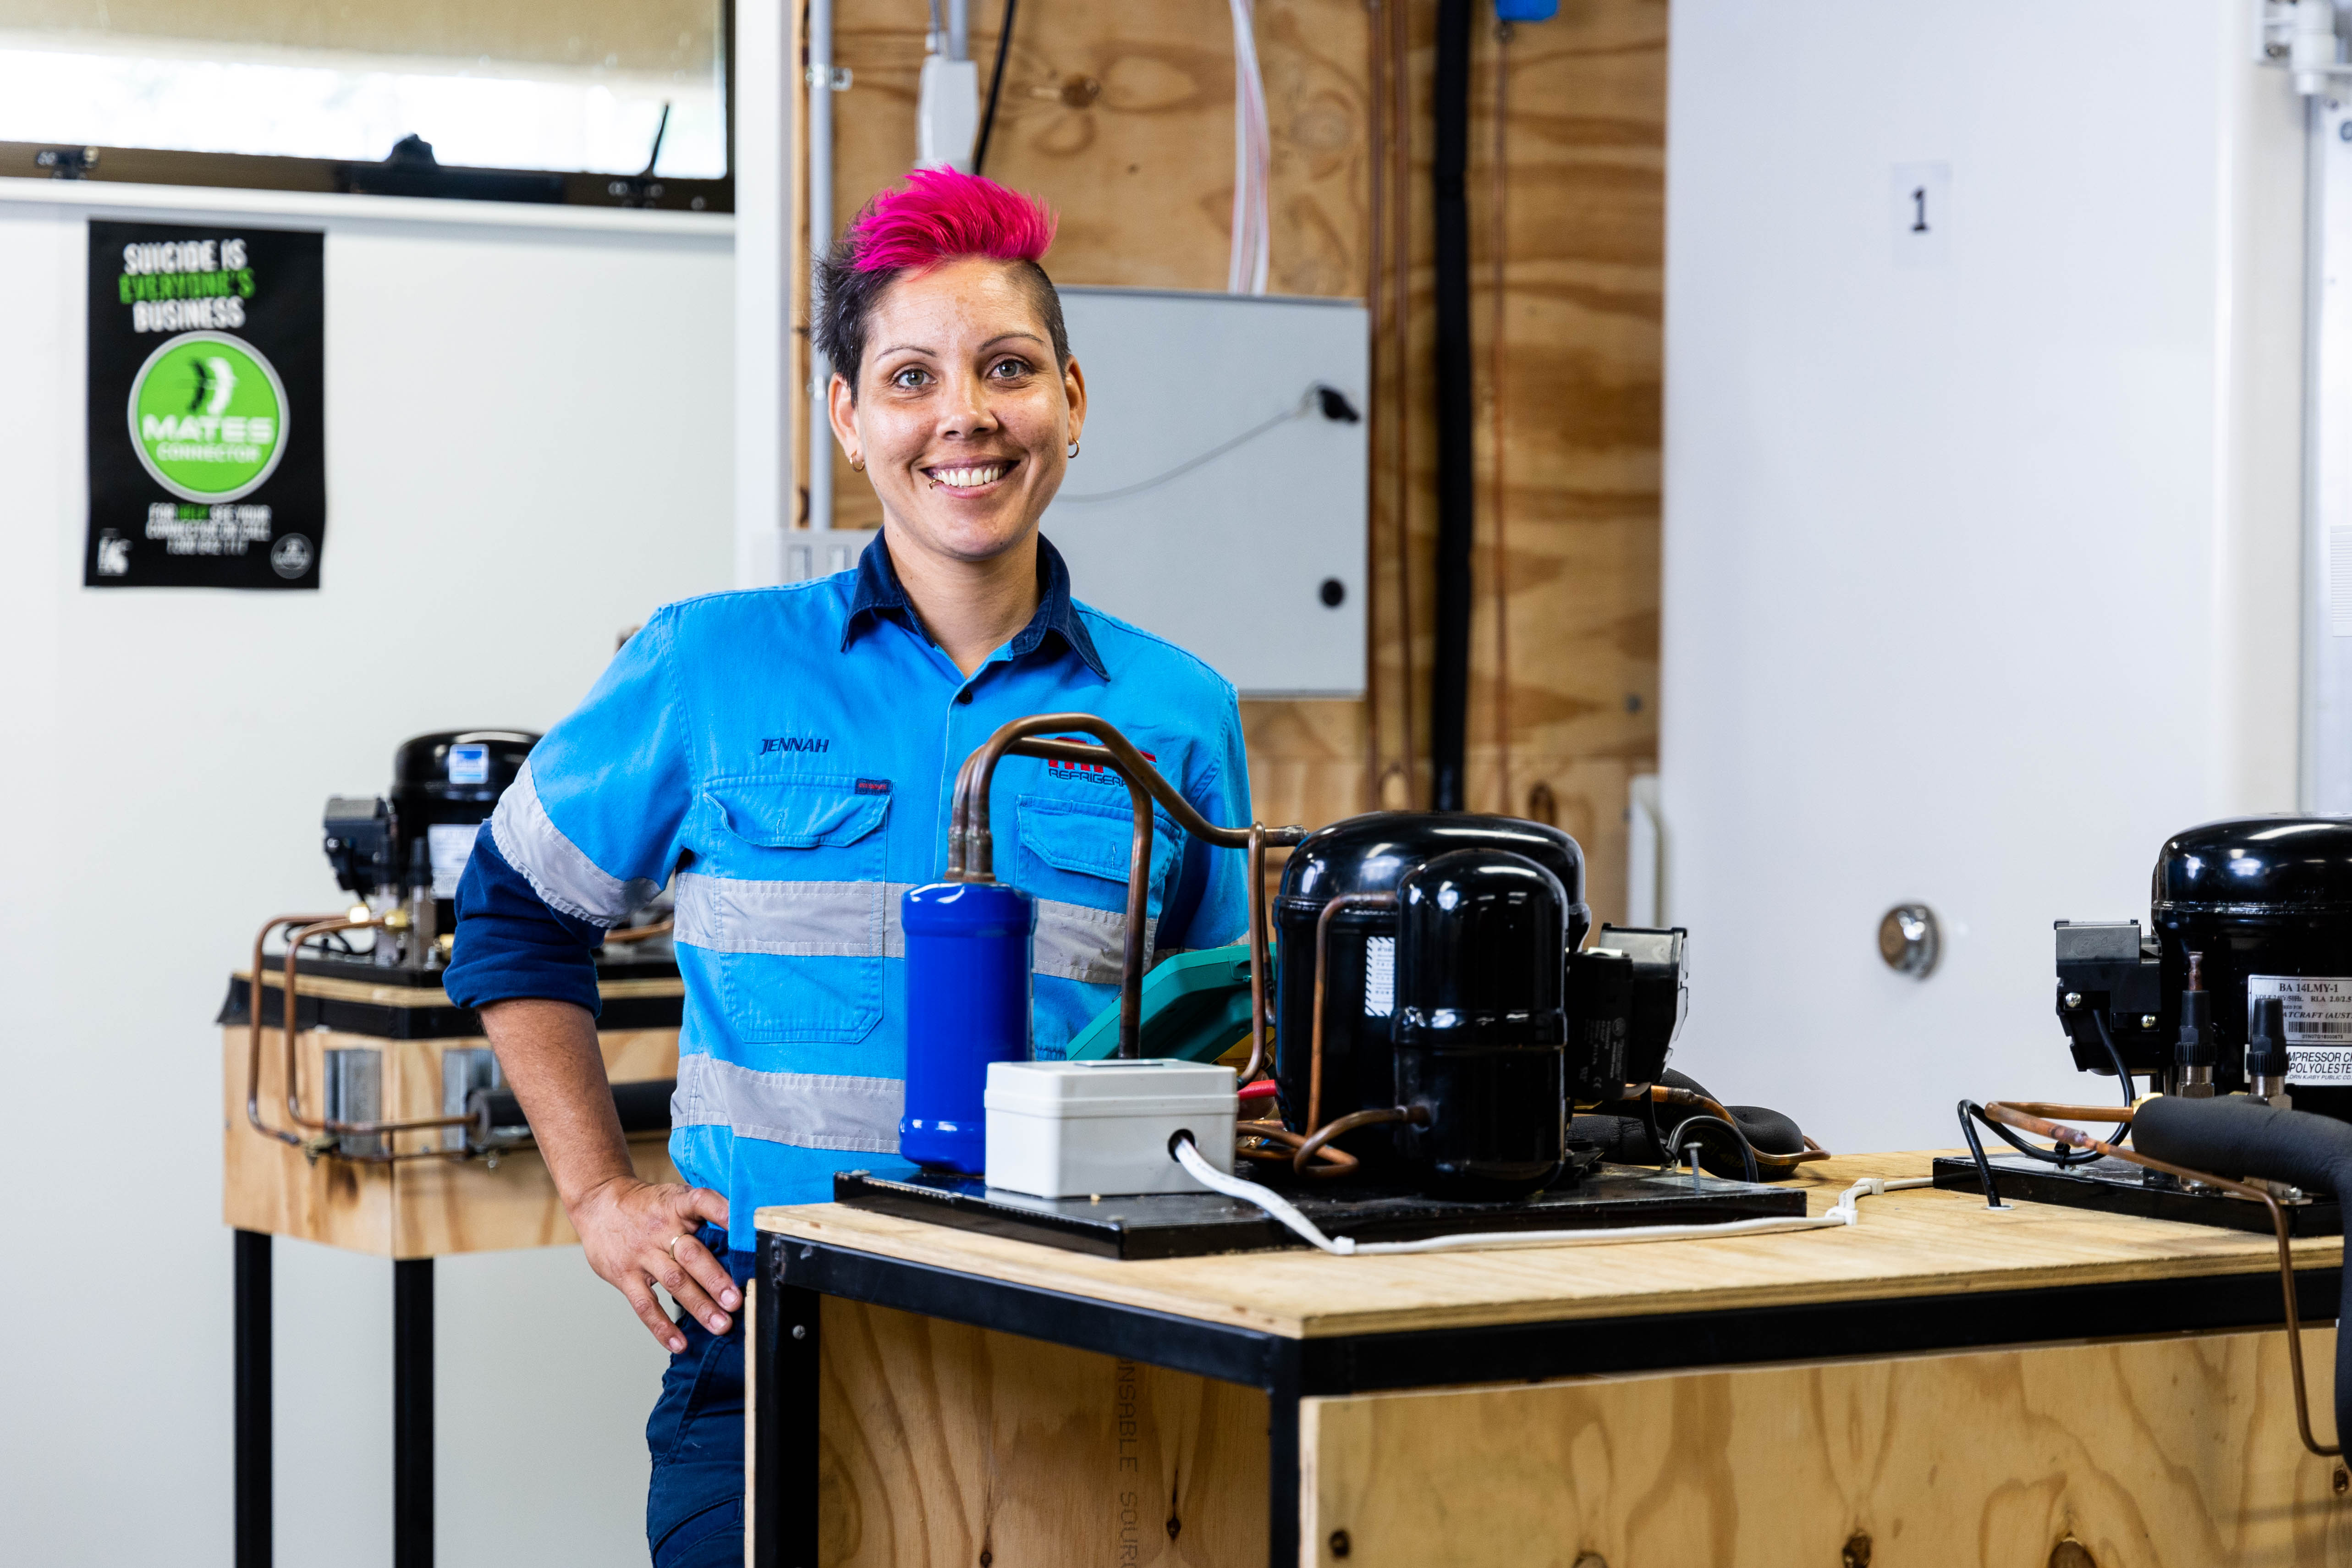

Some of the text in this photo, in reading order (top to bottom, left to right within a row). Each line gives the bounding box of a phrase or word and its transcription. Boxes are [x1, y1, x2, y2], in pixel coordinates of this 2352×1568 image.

[1911, 187, 1930, 233] 1
[123, 238, 248, 275] SUICIDE IS
[119, 267, 256, 304] EVERYONE'S
[133, 296, 246, 333] BUSINESS
[143, 413, 274, 444] MATES
[156, 442, 262, 463] CONNECTOR
[759, 737, 829, 755] JENNAH
[2279, 983, 2338, 993] BA 14LMY-1
